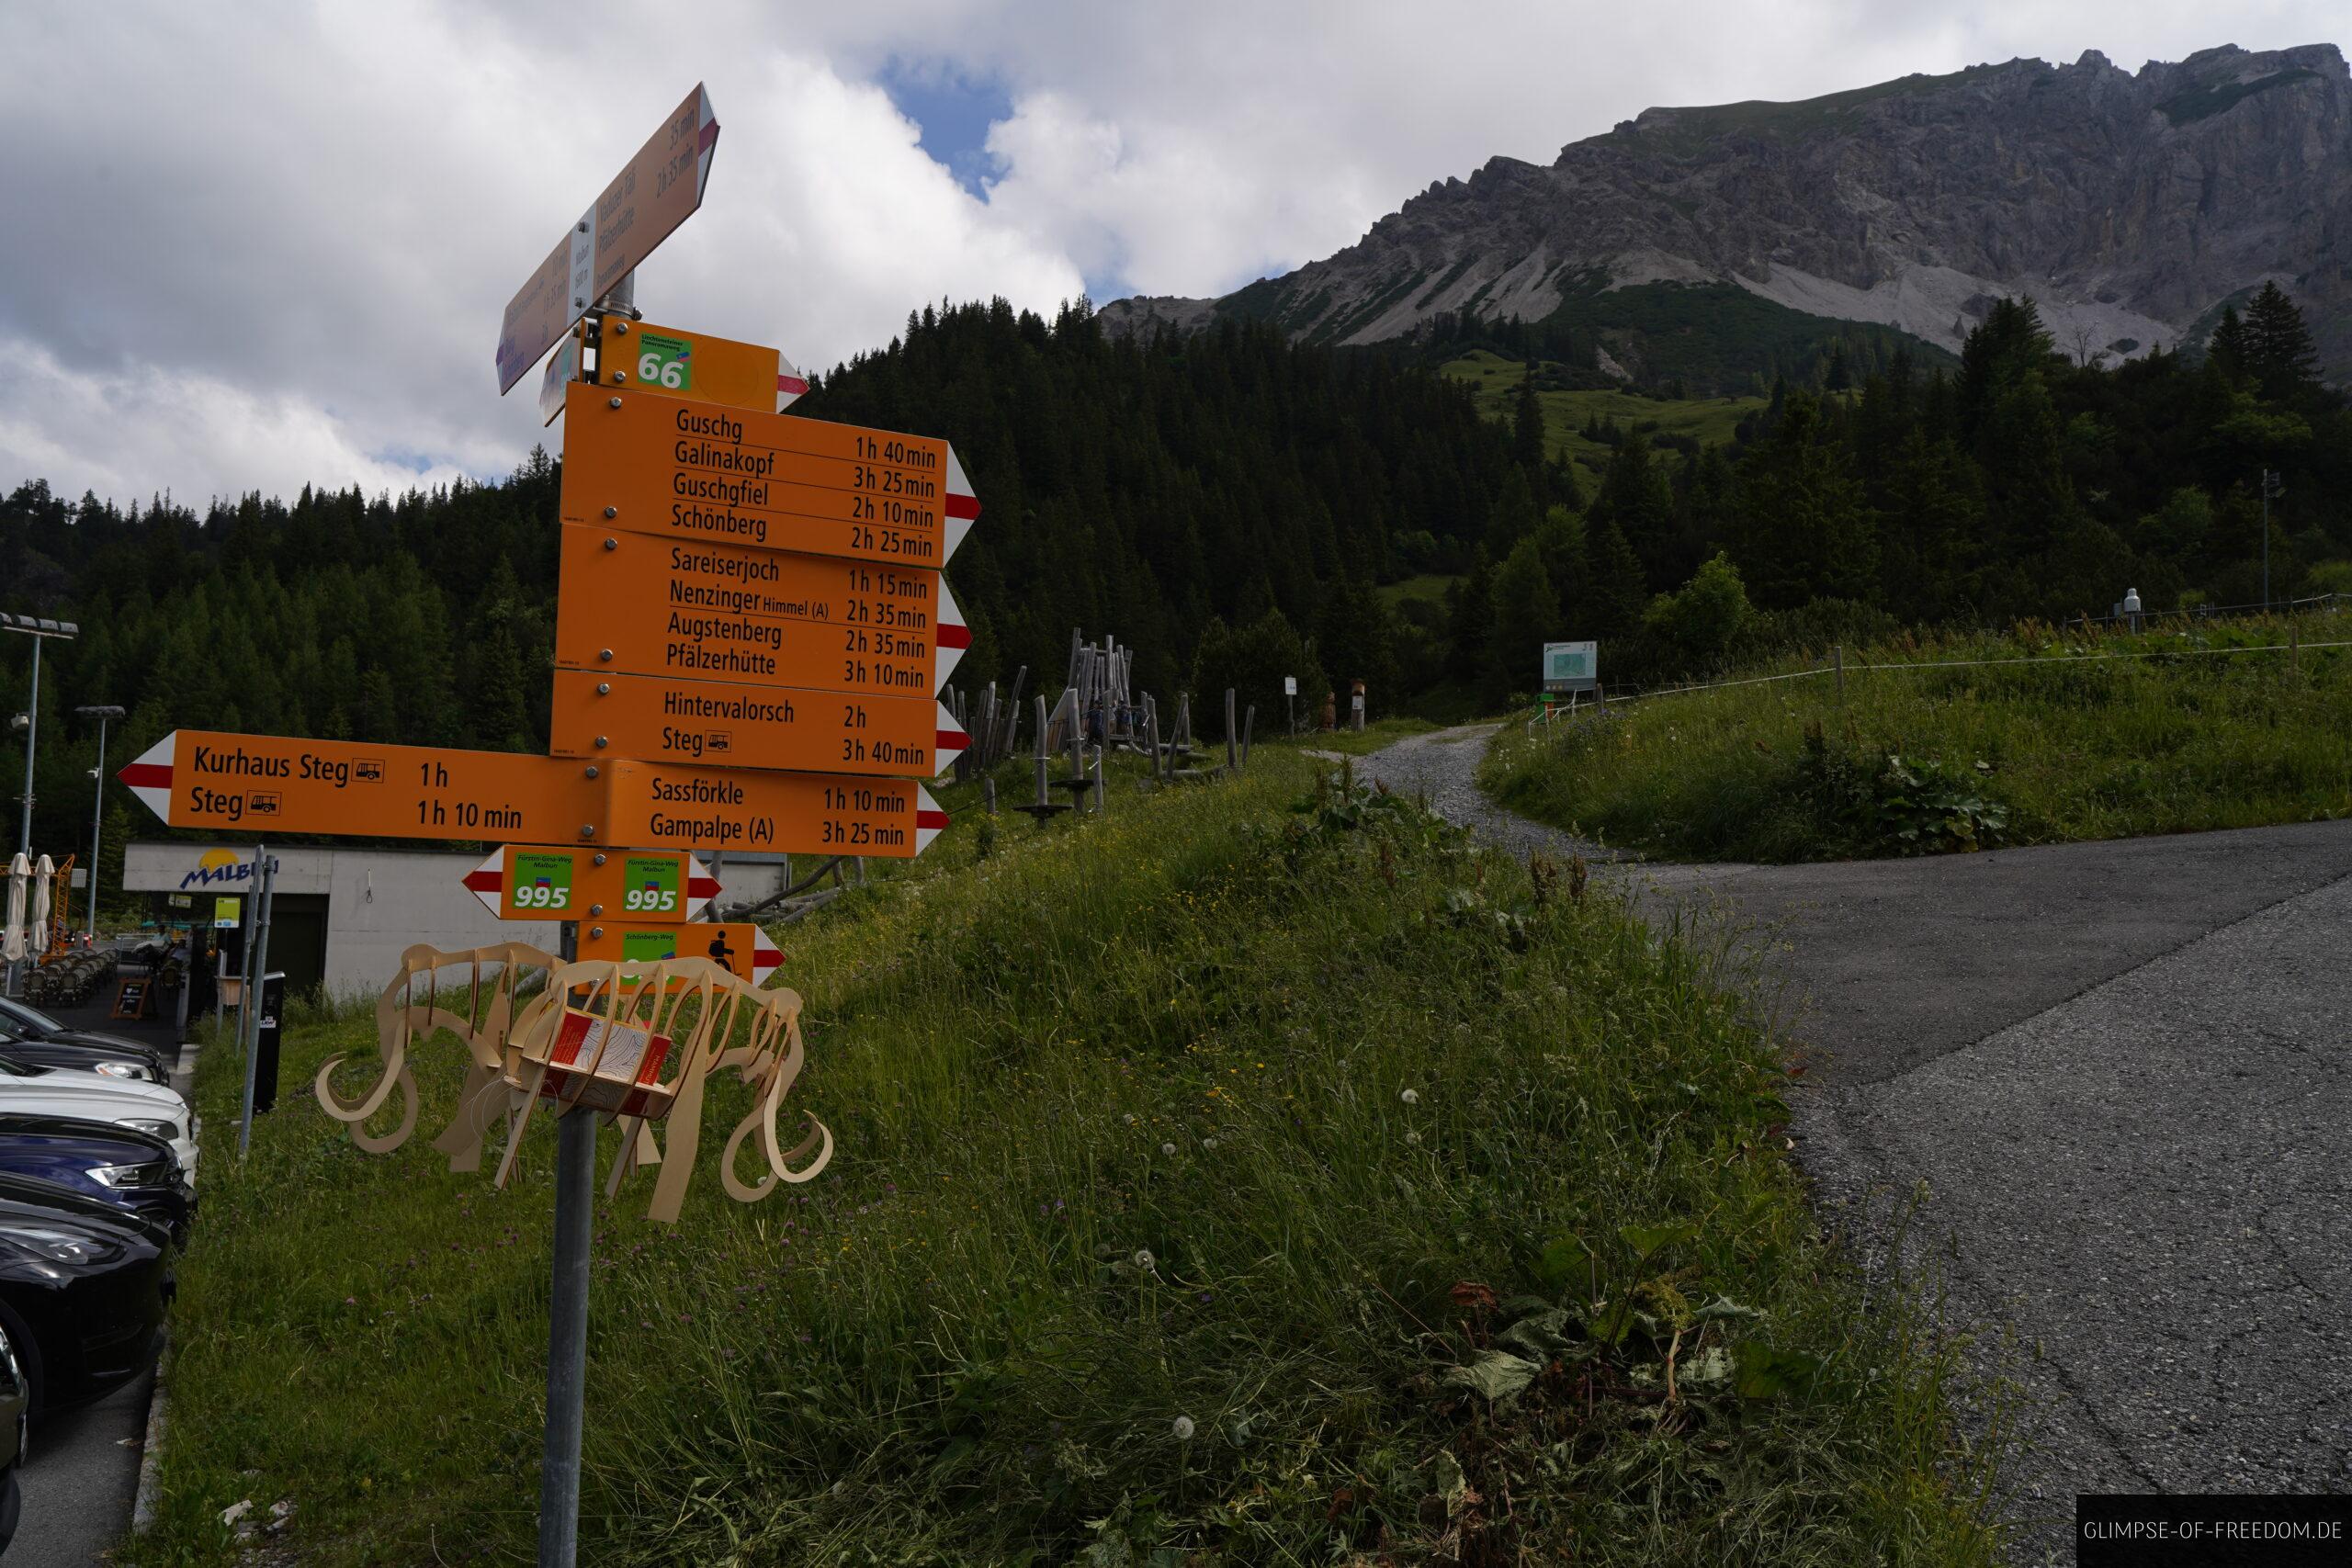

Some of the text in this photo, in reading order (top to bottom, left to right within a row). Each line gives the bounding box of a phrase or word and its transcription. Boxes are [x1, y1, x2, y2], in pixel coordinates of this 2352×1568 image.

[680, 106, 694, 140] min
[679, 142, 693, 176] min
[639, 353, 684, 389] 66
[676, 409, 742, 445] Guschg
[675, 441, 775, 479] Galinakopf
[673, 472, 768, 507] Guschgfiel
[672, 504, 766, 543] Schönberg
[672, 547, 779, 584] Sareiserjoch
[670, 579, 829, 620] Nenzinger Himmel (A)
[668, 612, 781, 649] Augstenberg
[667, 643, 775, 674] Pfälzerhütte
[664, 692, 794, 723] Hintervalorsch
[662, 727, 703, 757] Steg
[194, 746, 349, 787] Kurhaus Steg
[191, 786, 243, 821] Steg
[651, 777, 743, 805] Sassförkle
[650, 813, 774, 844] Gampalpe (A)
[517, 854, 572, 865] Fürstin-Gina-Weg
[628, 859, 679, 869] Fürstin-Gina-Weg
[642, 865, 665, 874] Malbun
[514, 886, 569, 908] 995
[626, 889, 676, 910] 995
[626, 932, 673, 941] Schönberg-Weg
